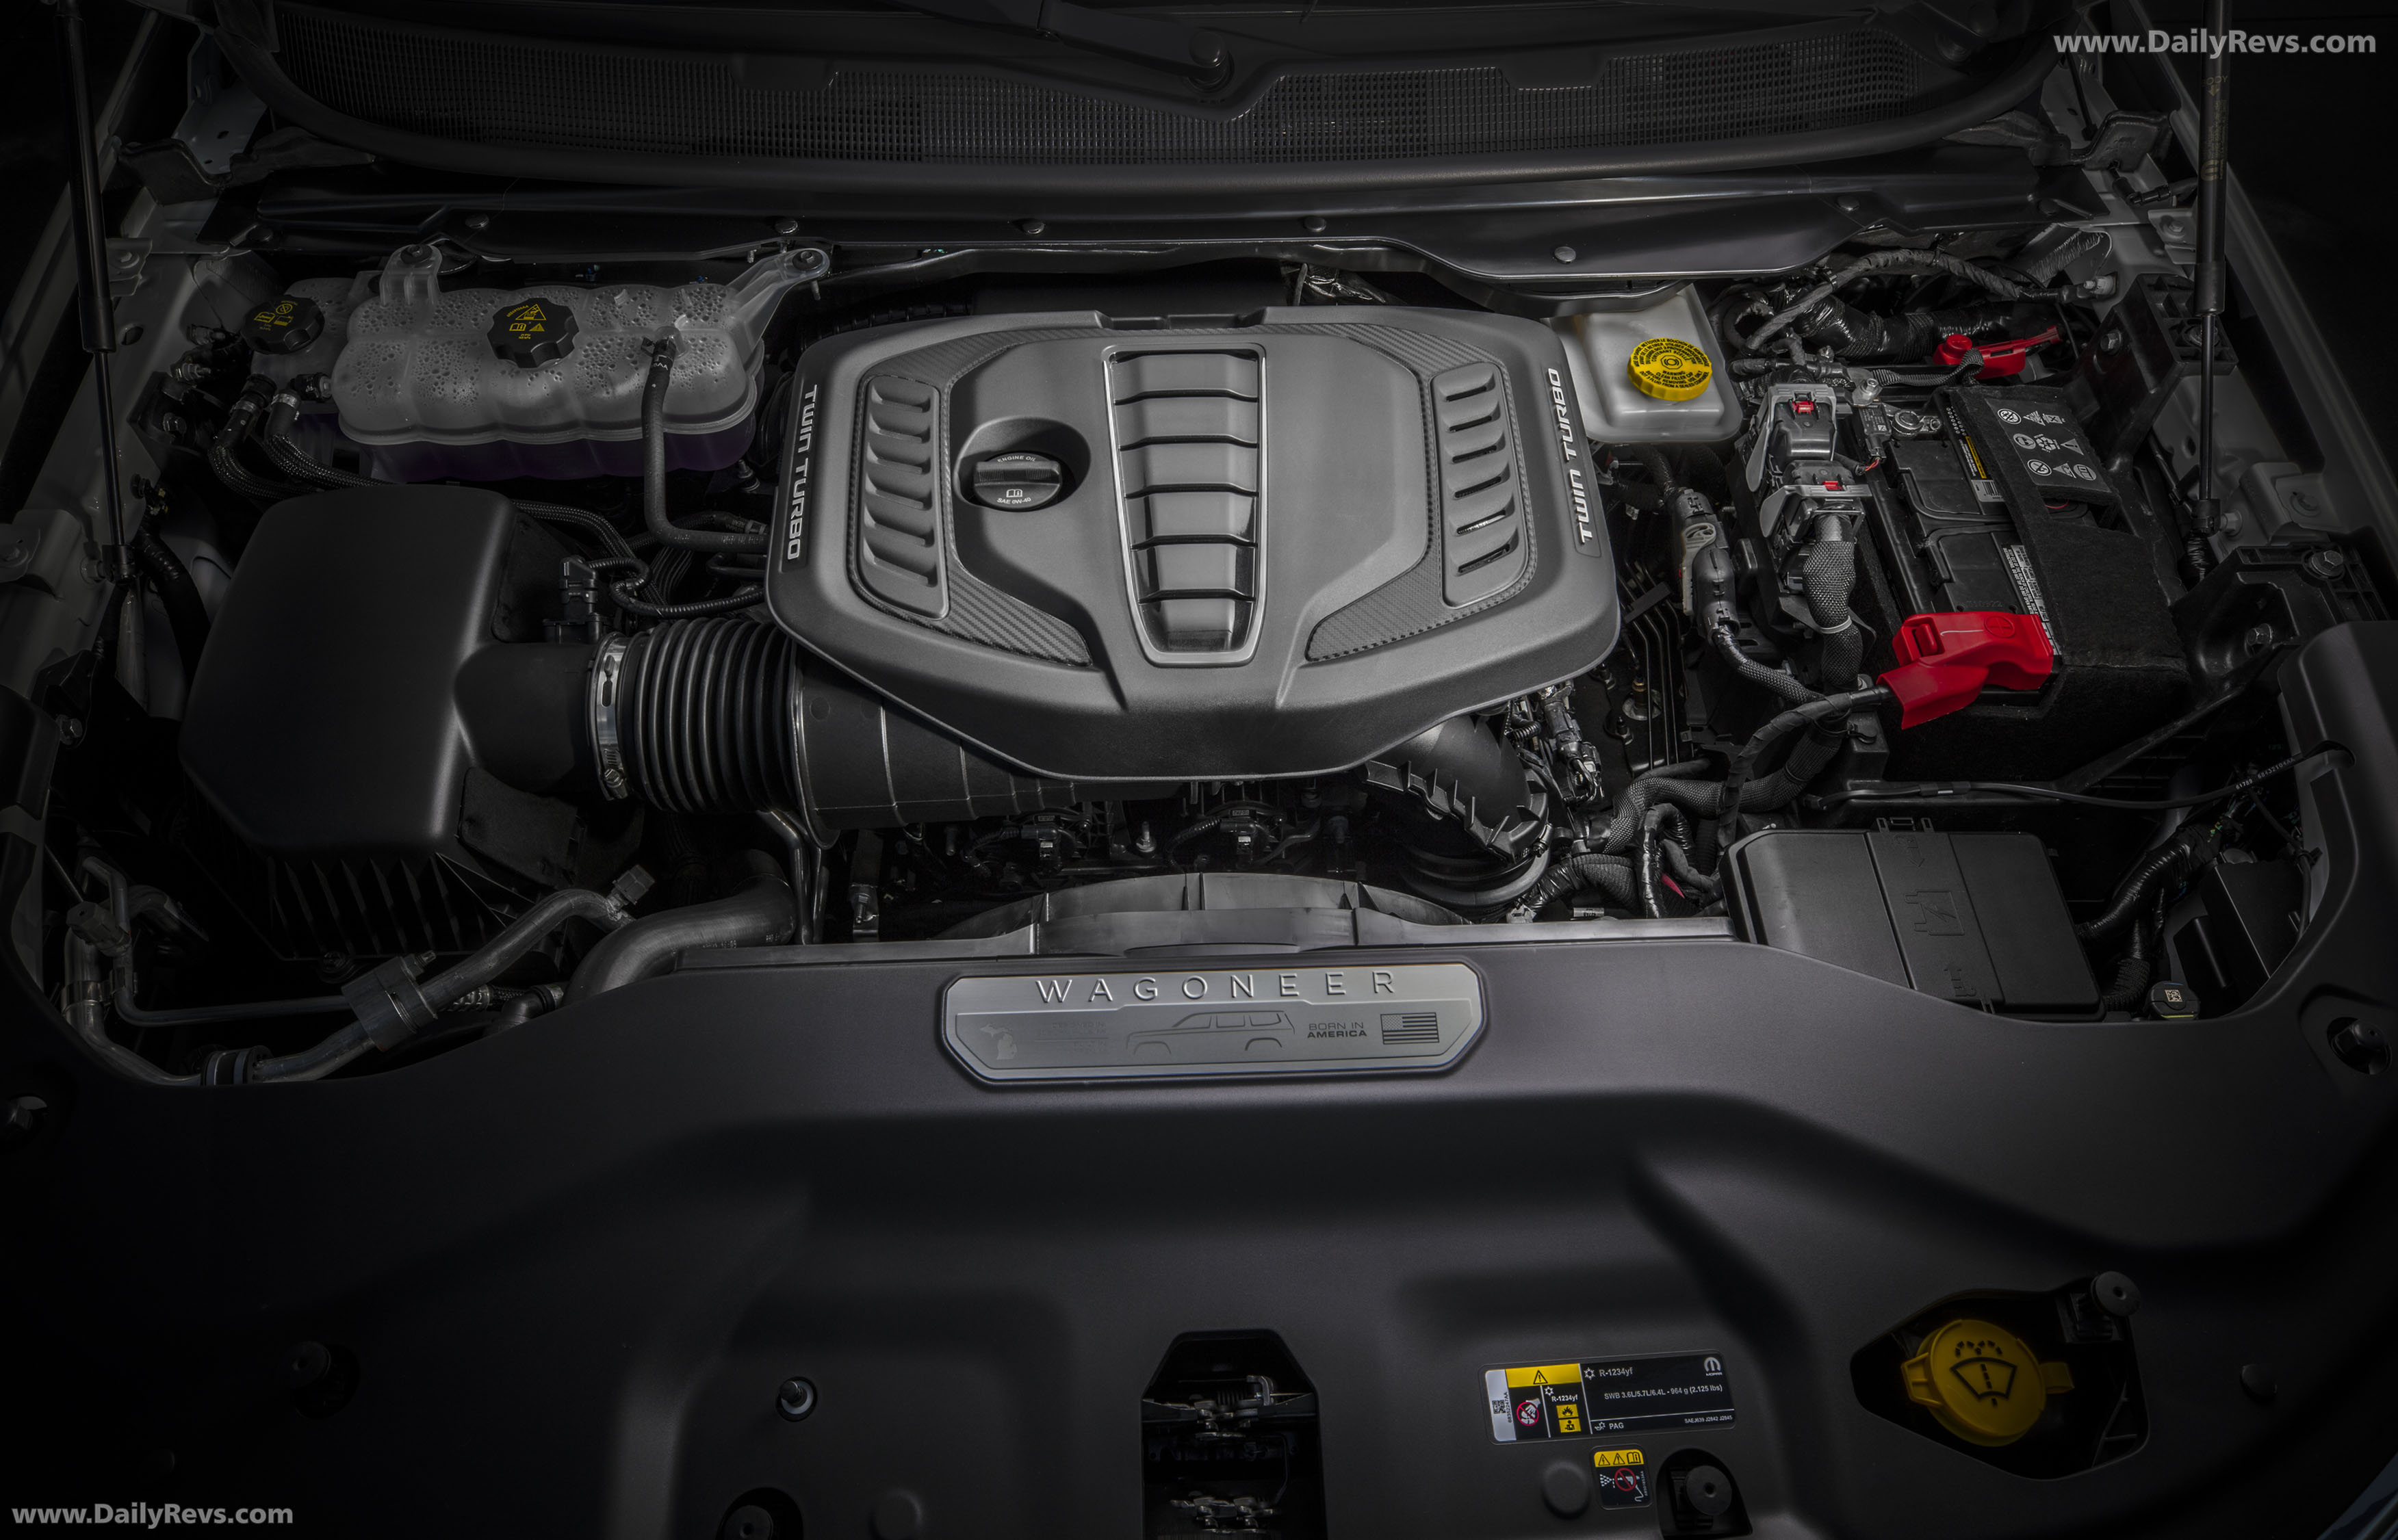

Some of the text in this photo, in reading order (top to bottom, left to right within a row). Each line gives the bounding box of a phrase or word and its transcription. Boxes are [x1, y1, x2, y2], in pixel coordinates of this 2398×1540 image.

[1641, 339, 1660, 347] NETTOYER
[1651, 350, 1671, 361] CONTENANT
[1667, 347, 1692, 356] PROVENANT
[1684, 348, 1703, 365] UNIQUEMENT
[1646, 371, 1661, 380] BEFORE
[1547, 368, 1593, 545] TWIN TURBO
[787, 384, 817, 560] TWIN TURBO
[1035, 971, 1395, 1003] WAGONEER
[1307, 1030, 1367, 1039] AMERICA
[1599, 1367, 1633, 1376] R-1234yf
[1621, 1388, 1666, 1398] 3.6L/5.7L/6.4L
[1689, 1385, 1709, 1394] (2.125
[1710, 1384, 1723, 1392] lbs)
[1551, 1394, 1578, 1402] R-1234yf
